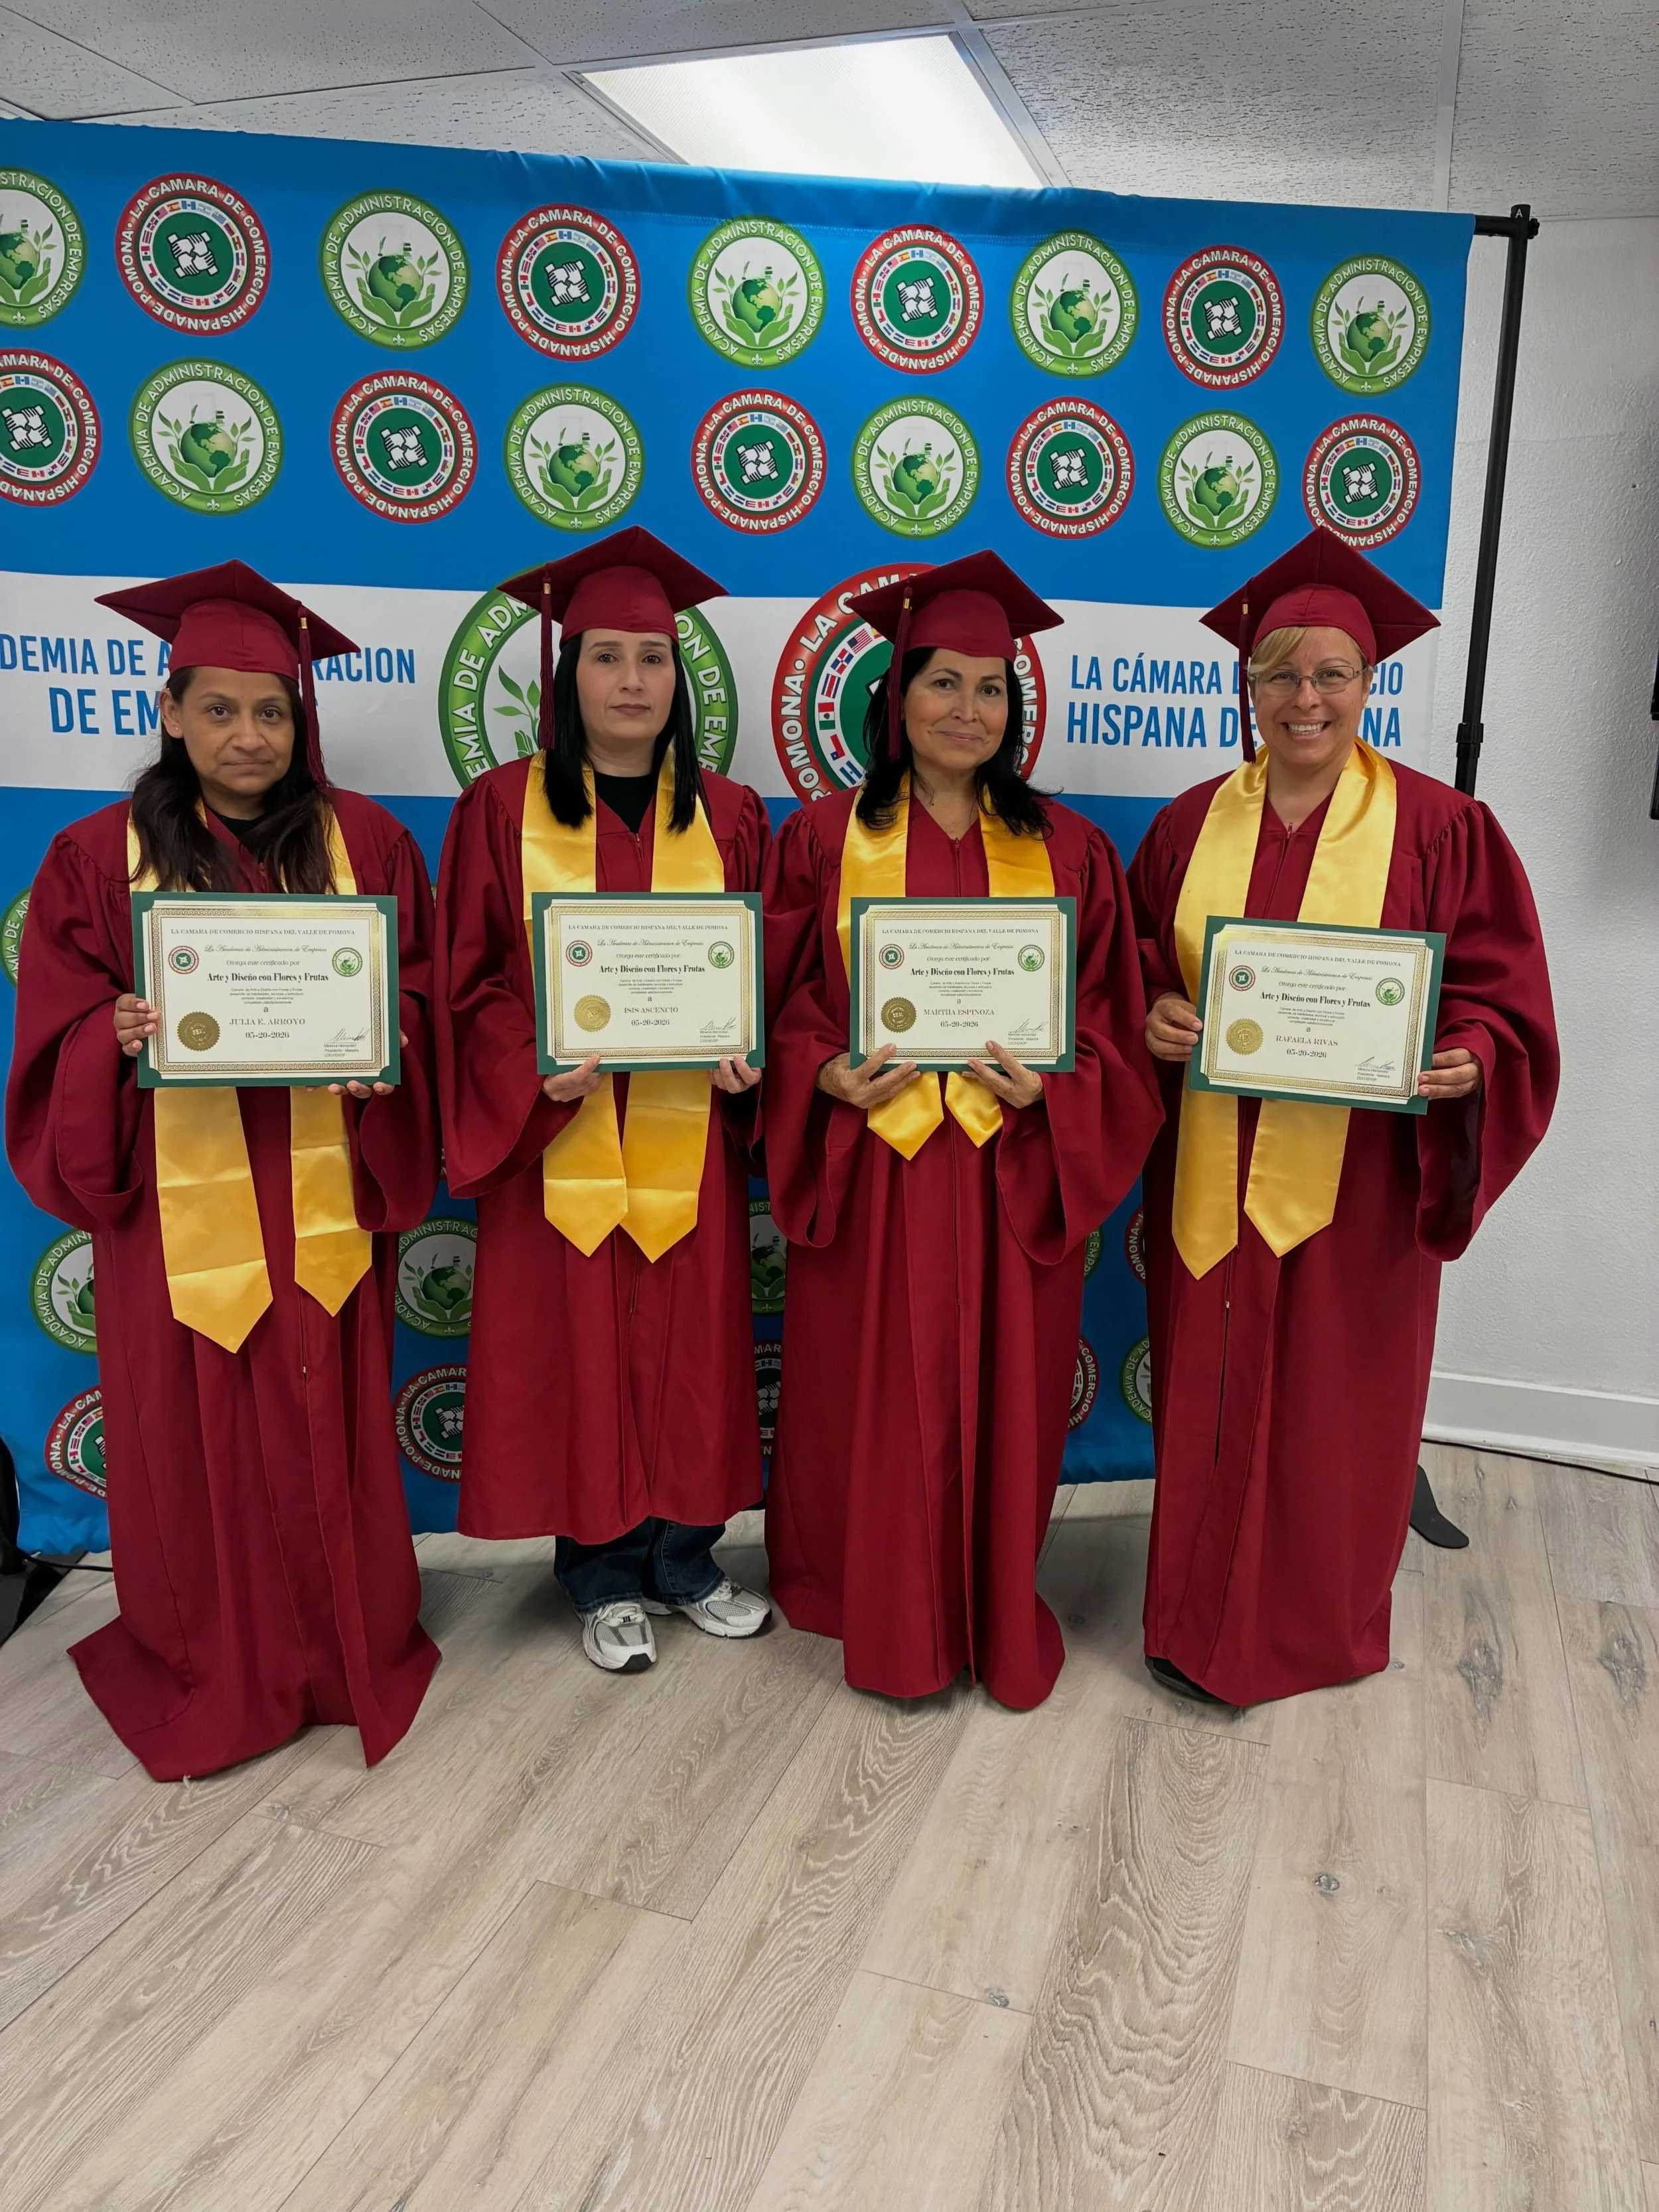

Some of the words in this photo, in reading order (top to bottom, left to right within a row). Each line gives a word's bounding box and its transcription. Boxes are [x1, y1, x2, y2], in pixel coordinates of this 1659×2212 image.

[149, 179, 218, 199] CAMARA
[222, 193, 245, 214] DE
[129, 198, 149, 220] LA
[337, 194, 457, 247] ADMINISTRACION
[528, 208, 593, 229] CAMARA
[64, 220, 80, 244] DE
[326, 232, 342, 254] DE
[510, 229, 528, 250] LA
[597, 222, 618, 244] DE
[121, 230, 153, 305] POMONA
[243, 215, 266, 307] COMERCIO
[449, 250, 465, 271] DE
[1028, 234, 1129, 286] ADMINISTRACION
[1175, 269, 1192, 289] LA
[1192, 250, 1248, 269] CAMARA
[1251, 261, 1269, 281] DE
[38, 248, 81, 319] EMPRESAS
[326, 259, 378, 336] ACADEMIA
[501, 260, 529, 332] POMONA
[614, 244, 635, 332] COMERCIO
[1017, 275, 1029, 296] DE
[1121, 289, 1134, 309] DE
[1327, 258, 1422, 303] ADMINISTRACION
[419, 276, 466, 342] EMPRESAS
[1261, 280, 1282, 362] COMERCIO
[1317, 294, 1330, 313] DE
[1415, 304, 1427, 324] DE
[1014, 301, 1055, 367] ACADEMIA
[1090, 313, 1134, 373] EMPRESAS
[1165, 298, 1187, 364] POMONA
[1315, 317, 1352, 383] ACADEMIA
[1384, 328, 1427, 388] EMPRESAS
[147, 363, 269, 413] ADMINISTRACION
[344, 394, 363, 415] LA
[362, 375, 429, 395] CAMARA
[433, 389, 453, 409] DE
[722, 394, 783, 413] CAMARA
[53, 366, 74, 388] DE
[73, 387, 96, 476] COMERCIO
[135, 401, 152, 422] DE
[263, 415, 279, 437] DE
[521, 388, 632, 435] ADMINISTRACION
[705, 413, 722, 433] LA
[786, 404, 806, 424] DE
[1331, 419, 1386, 437] CAMARA
[451, 409, 472, 495] COMERCIO
[510, 425, 525, 445] DE
[626, 436, 640, 457] DE
[1174, 415, 1270, 457] ADMINISTRACION
[1315, 437, 1331, 456] LA
[1388, 429, 1406, 447] DE
[136, 428, 192, 502] ACADEMIA
[234, 441, 280, 507] EMPRESAS
[336, 425, 366, 494] POMONA
[695, 443, 721, 509] POMONA
[801, 423, 822, 506] COMERCIO
[1163, 451, 1177, 469] DE
[1263, 459, 1275, 478] DE
[510, 451, 557, 520] ACADEMIA
[595, 461, 640, 524] EMPRESAS
[1304, 465, 1325, 527] POMONA
[1396, 447, 1418, 524] COMERCIO
[1161, 474, 1199, 538] ACADEMIA
[1232, 481, 1275, 541] EMPRESAS
[800, 614, 838, 653] LA
[107, 639, 146, 676] DE
[453, 648, 486, 691] DE
[697, 665, 726, 706] DE
[1071, 654, 1102, 690] LA
[1113, 652, 1222, 694] CÁMARA
[49, 687, 100, 735] DE
[1067, 701, 1207, 747] HISPANA
[1260, 992, 1275, 1001] Arte
[1319, 995, 1341, 1005] Flores
[1348, 998, 1370, 1007] Frutas
[1276, 1035, 1311, 1045] RAFAELA
[1286, 1049, 1327, 1058] 05-20-2026
[36, 1268, 51, 1287] DE
[36, 1291, 87, 1348] ACADEMIA
[402, 1384, 419, 1399] LA
[418, 1367, 467, 1386] CAMAR
[1126, 1357, 1139, 1370] DE
[1125, 1374, 1151, 1419] CADEMIA
